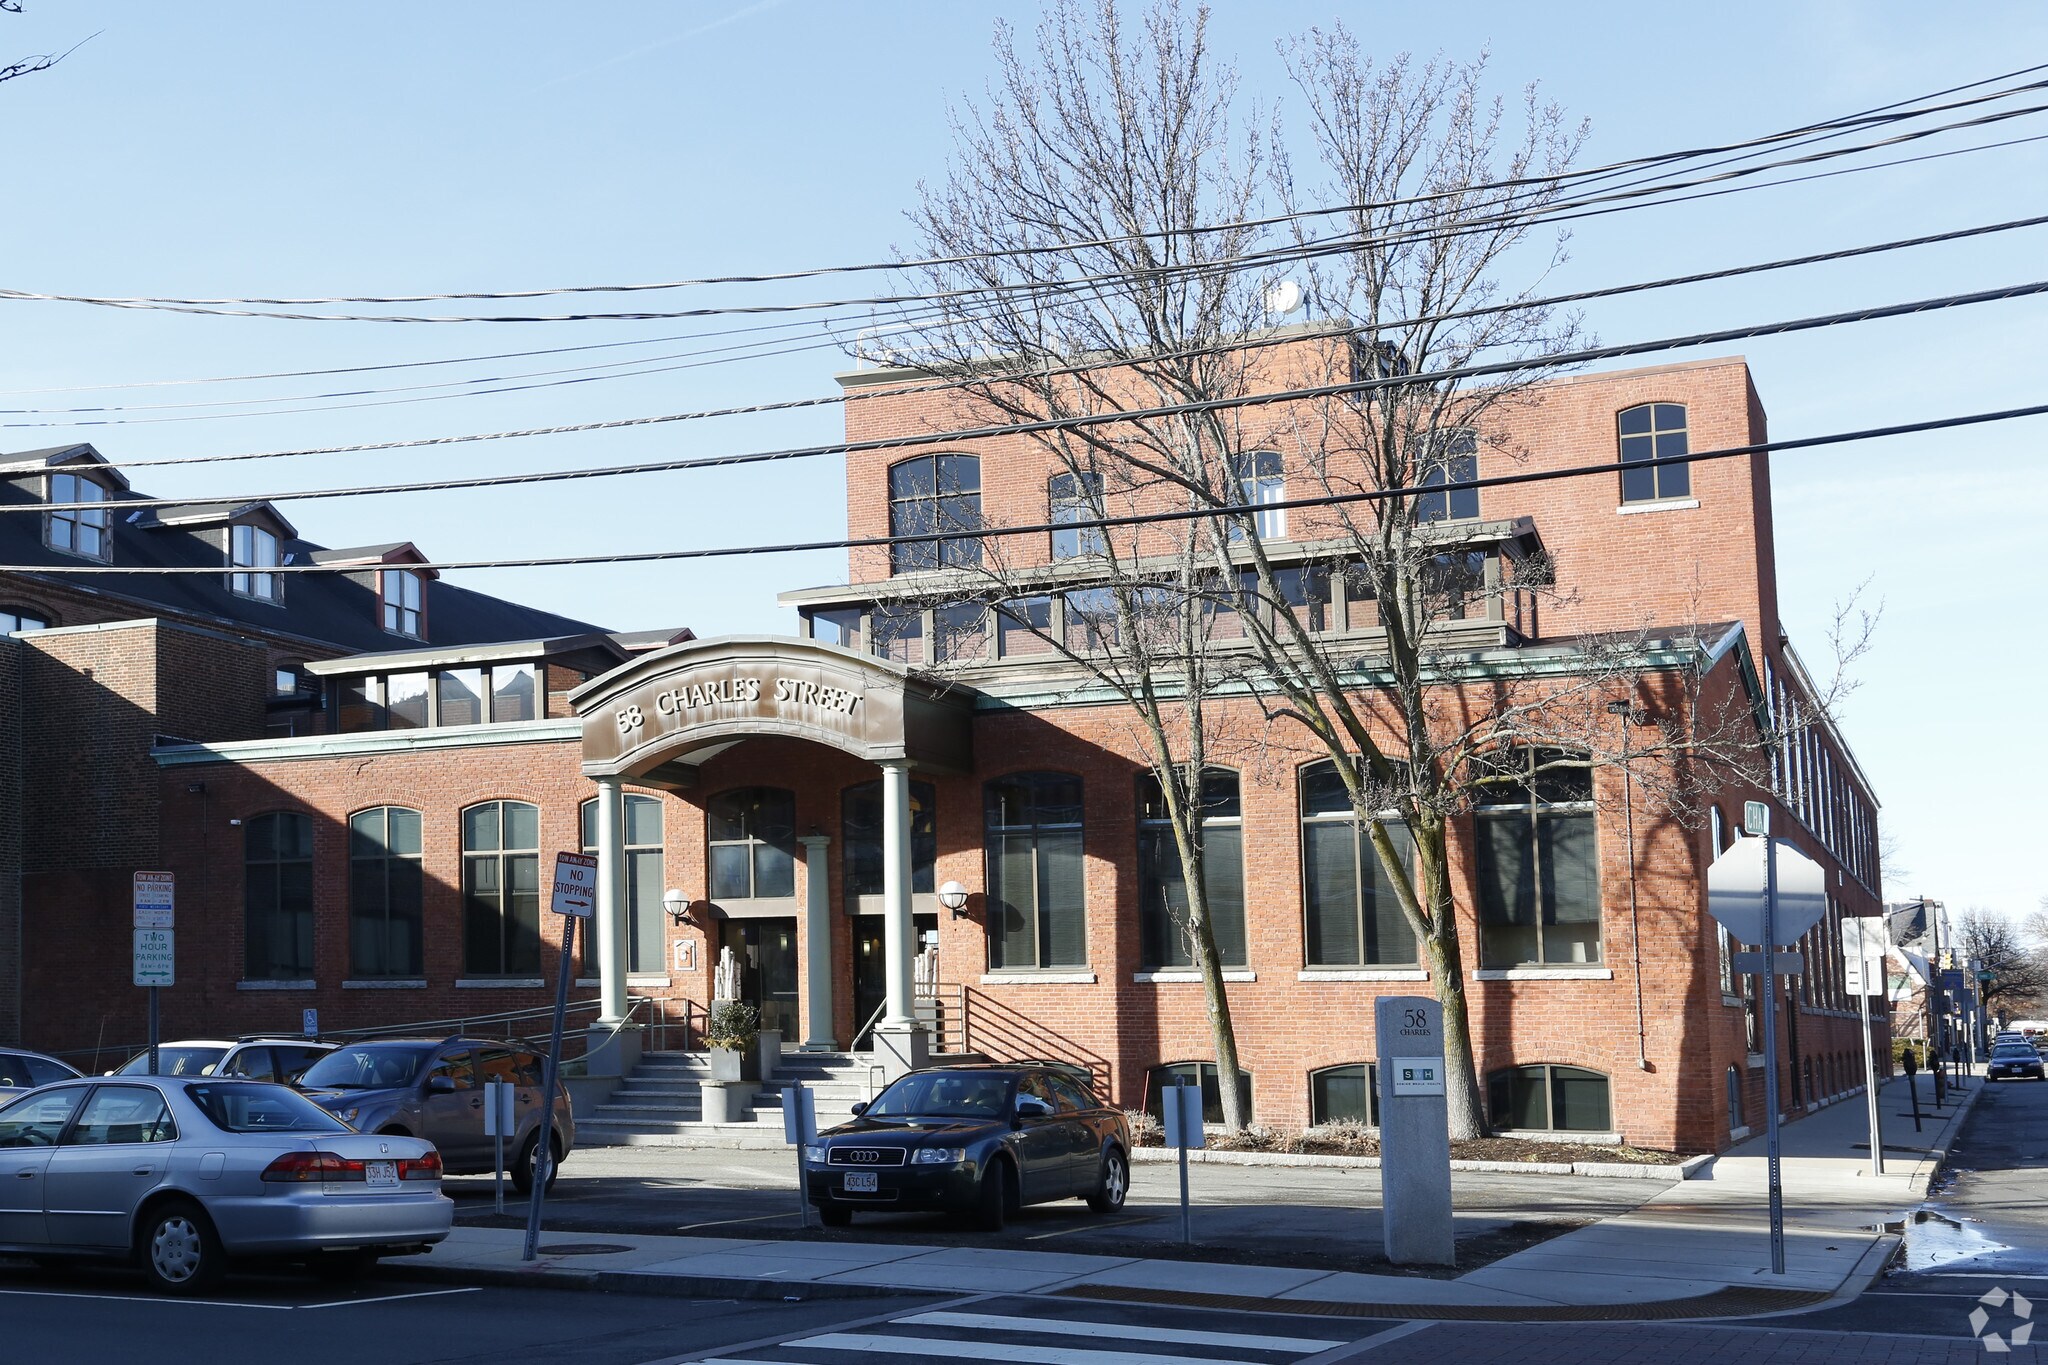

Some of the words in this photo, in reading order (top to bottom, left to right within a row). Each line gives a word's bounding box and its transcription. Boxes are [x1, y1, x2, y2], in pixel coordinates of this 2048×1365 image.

[615, 704, 645, 734] 58
[655, 677, 761, 717] CHARLES
[773, 677, 864, 716] STREET
[559, 854, 569, 862] TOW
[583, 858, 596, 866] ZONE
[570, 869, 584, 882] NO
[136, 883, 145, 892] NO
[147, 883, 172, 893] PARKING
[555, 881, 593, 898] STOPPING
[144, 934, 165, 942] TWO
[140, 943, 167, 951] HOUR
[136, 953, 173, 961] PARKING
[1404, 1008, 1427, 1029] 58
[1399, 1028, 1431, 1036] CHARLES
[1404, 1070, 1433, 1079] SWH
